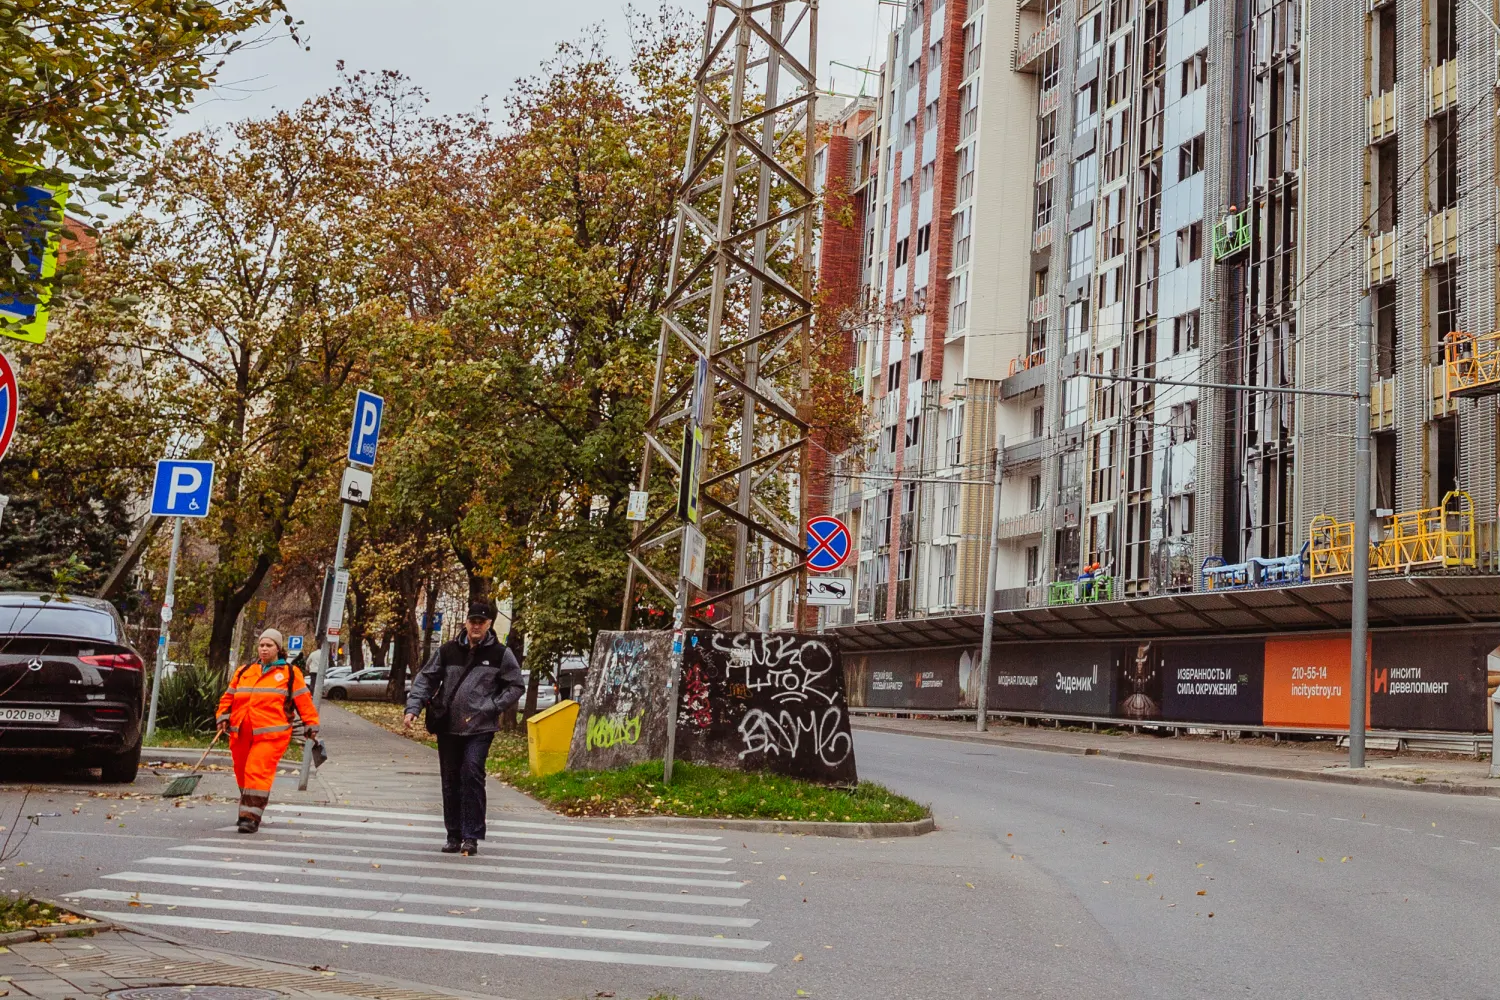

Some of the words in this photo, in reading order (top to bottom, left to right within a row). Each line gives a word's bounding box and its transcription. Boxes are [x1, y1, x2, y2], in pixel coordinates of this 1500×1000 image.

[167, 466, 203, 510] P
[1177, 668, 1225, 680] ИЗБРАННОСТЬ
[1225, 668, 1232, 680] И
[1291, 666, 1327, 680] 210-55-14
[1055, 671, 1092, 694] Эндемик
[1176, 683, 1195, 695] СИЛА
[1195, 683, 1237, 695] ОКРУЖЕНИЯ
[1291, 683, 1342, 699] incitystroy.ru
[45, 710, 56, 718] 93
